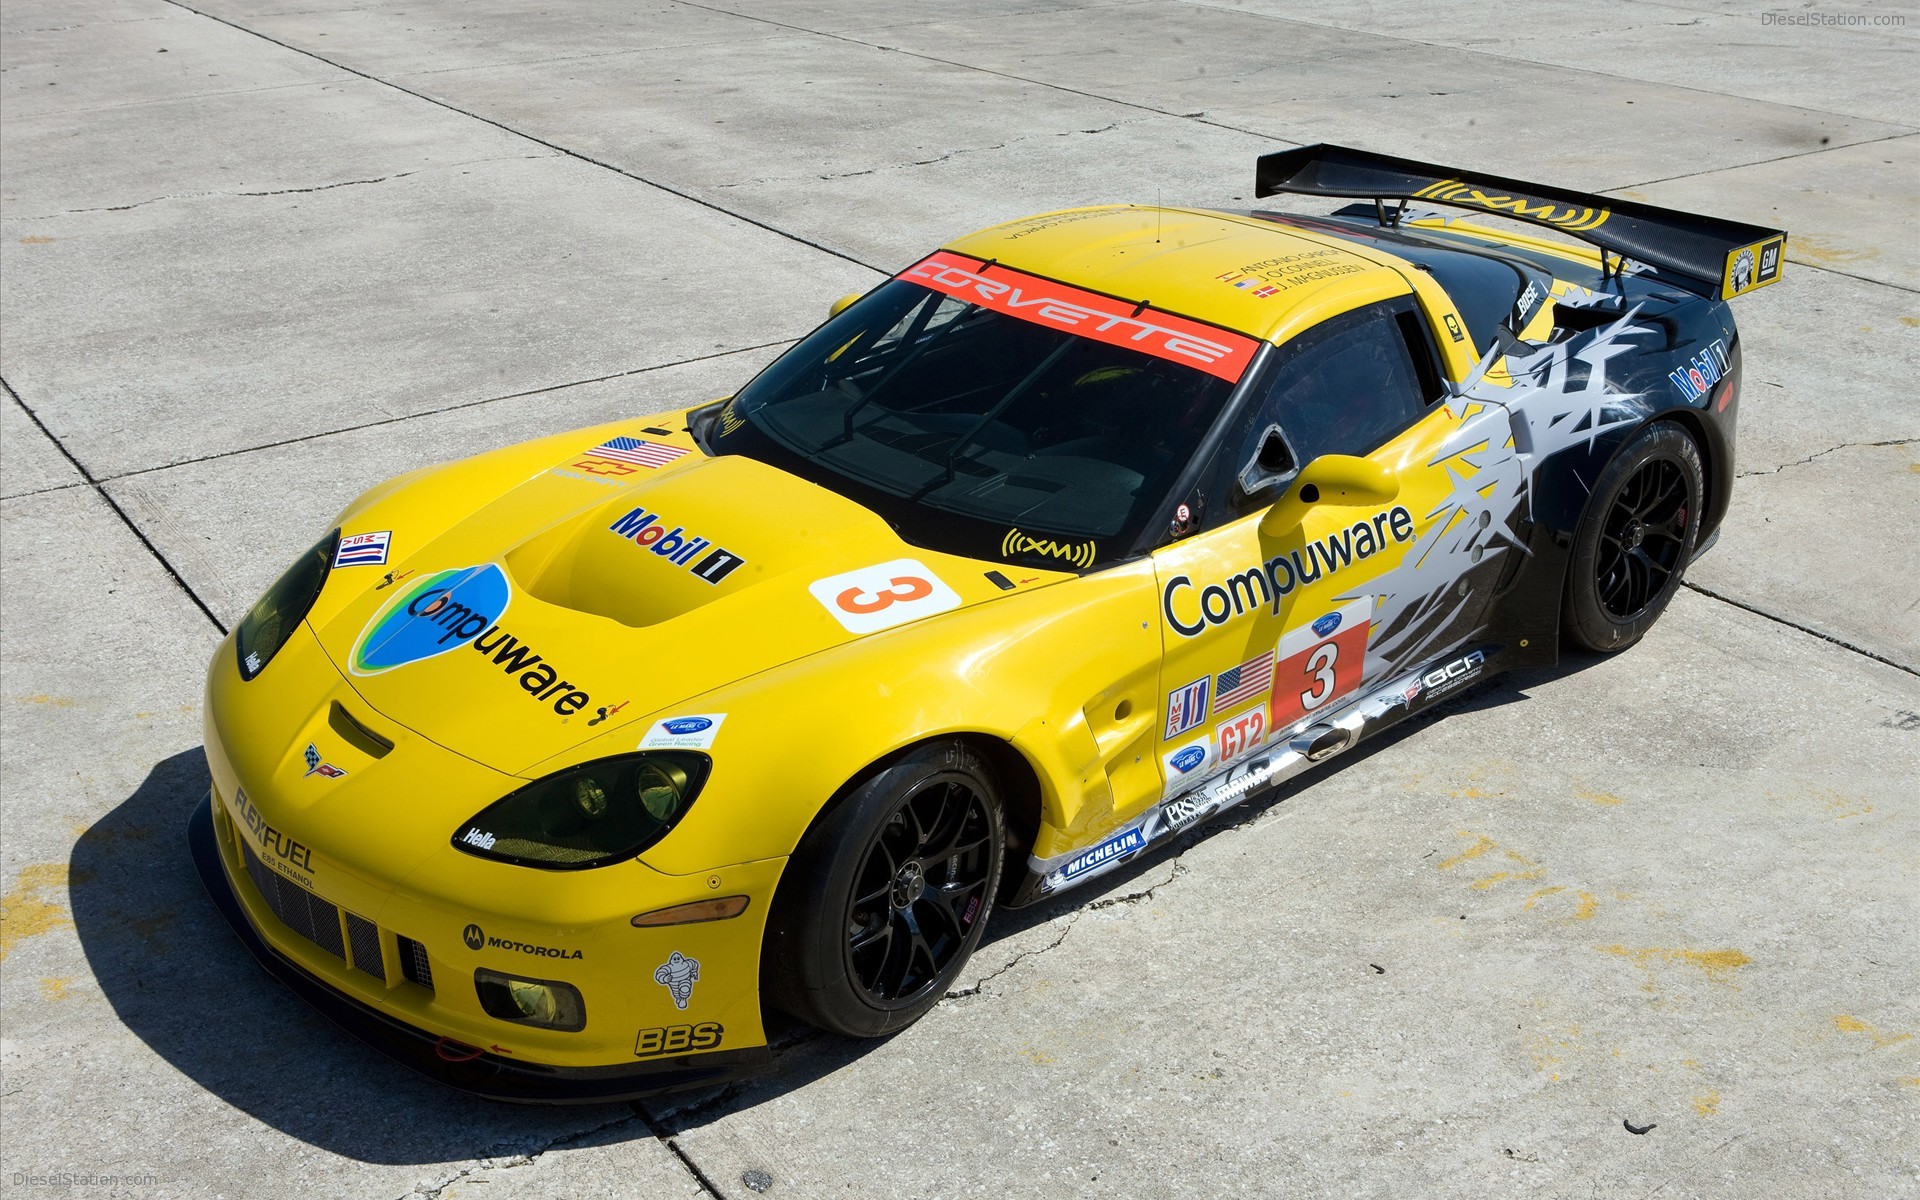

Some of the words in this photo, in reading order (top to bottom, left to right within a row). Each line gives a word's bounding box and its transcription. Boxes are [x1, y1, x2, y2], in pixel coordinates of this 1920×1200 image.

[1240, 253, 1300, 274] ANTONIO
[1291, 264, 1366, 286] MAGNUSSEN
[1762, 247, 1778, 269] GM
[909, 261, 1234, 363] CORVETTE
[1517, 280, 1539, 320] BOSE
[1668, 347, 1722, 404] Mobil
[608, 505, 712, 567] Mobil
[1163, 506, 1414, 636] Compuware
[836, 576, 934, 615] 3
[408, 587, 590, 716] Compuware
[1424, 650, 1485, 688] GCA
[1301, 641, 1339, 711] 3
[1221, 712, 1263, 761] GT2
[1165, 797, 1197, 823] PRS
[463, 827, 496, 850] Hella
[1067, 833, 1138, 875] MICHELIN
[262, 852, 276, 866] E85
[277, 863, 314, 889] ETHANOL
[963, 897, 979, 924] BBS
[488, 936, 583, 959] MOTOROLA
[634, 1021, 724, 1057] BBS
